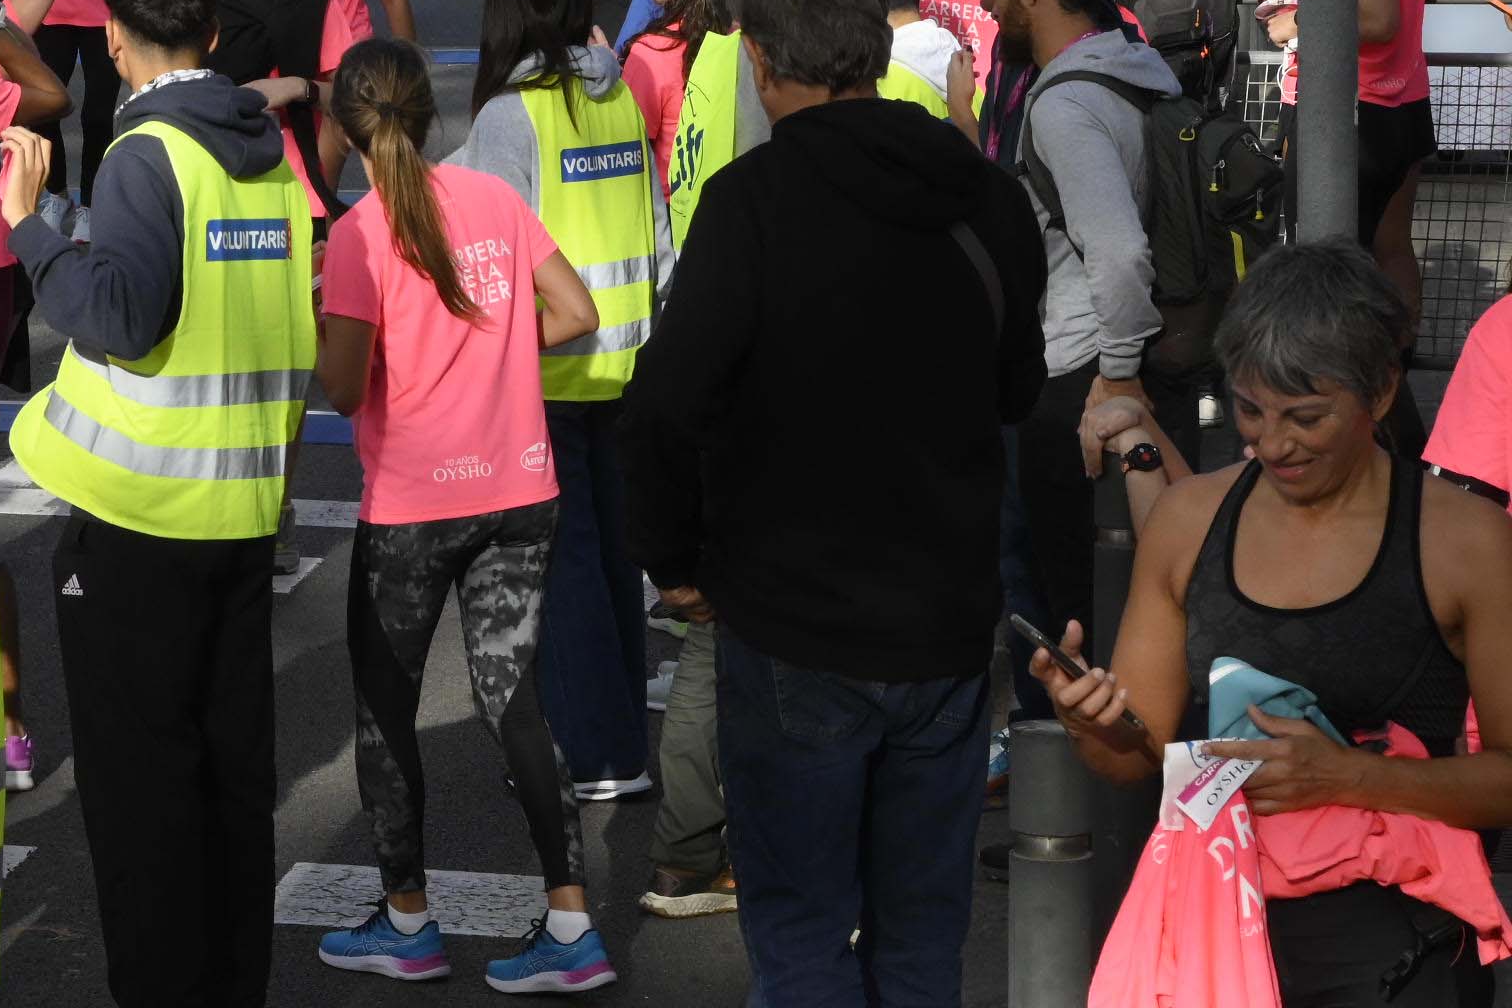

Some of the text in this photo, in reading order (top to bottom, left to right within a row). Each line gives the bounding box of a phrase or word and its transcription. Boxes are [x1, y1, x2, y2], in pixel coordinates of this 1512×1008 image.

[958, 19, 979, 37] LA
[562, 148, 644, 176] VOLUNTARIS
[208, 229, 287, 251] VOLUNTARIS
[477, 263, 504, 282] LA
[469, 280, 513, 307] UJER
[445, 455, 479, 467] 10 AÑOS
[433, 462, 492, 482] OYSHO
[61, 586, 84, 597] adidas
